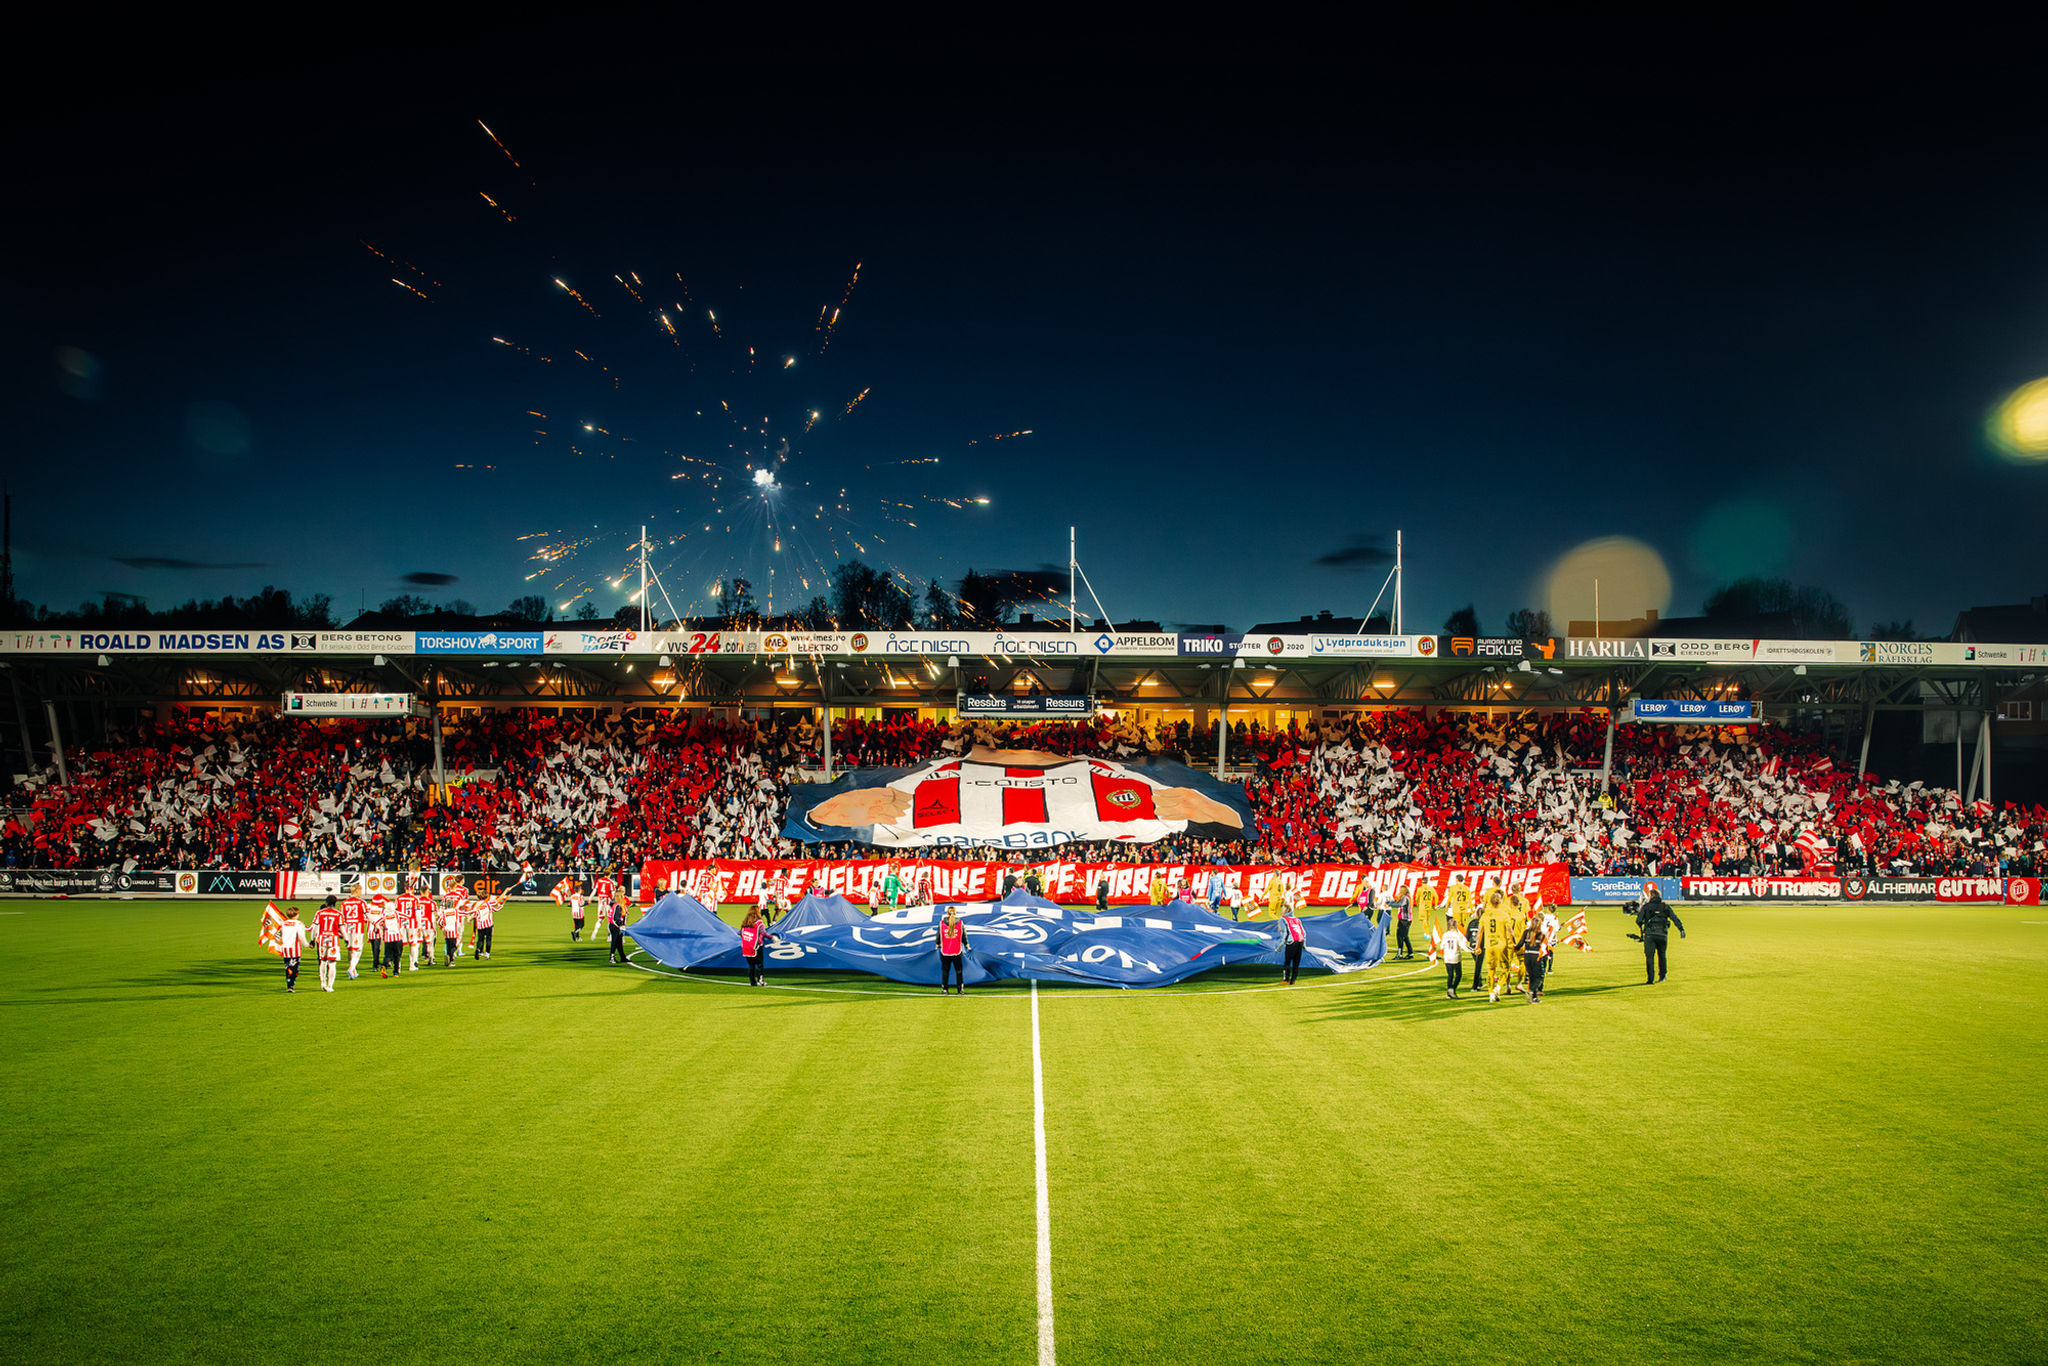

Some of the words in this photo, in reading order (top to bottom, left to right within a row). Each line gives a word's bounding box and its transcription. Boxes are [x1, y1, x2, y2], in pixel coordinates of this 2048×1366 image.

[80, 634, 151, 650] ROALD
[159, 634, 249, 650] MADSEN
[256, 634, 285, 650] AS
[419, 637, 477, 649] TORSHOV
[499, 637, 539, 650] SPORT
[886, 633, 919, 653] ÅGE
[921, 640, 970, 653] NILSEN
[1029, 640, 1078, 653] NILSEN
[1115, 637, 1175, 646] APPELBOM
[1183, 638, 1223, 653] TRIKO
[1286, 643, 1305, 651] 2020
[1326, 637, 1406, 648] Lydproduksjon
[1680, 643, 1710, 651] ODD
[1714, 643, 1751, 651] BERG
[797, 643, 839, 652] ELEKTRO
[1477, 645, 1523, 656] FOKUS
[1569, 640, 1645, 657] HARILA
[1878, 643, 1933, 655] NORGES
[1977, 650, 2008, 659] Schwenke
[305, 699, 338, 708] Schwenke
[967, 697, 1007, 707] Ressurs
[1045, 698, 1085, 708] Ressurs
[1640, 704, 1668, 712] LERØY
[1680, 704, 1707, 712] LERØY
[1719, 705, 1746, 713] LERØY
[1115, 793, 1134, 802] TIL
[239, 879, 271, 888] AVARN
[735, 867, 808, 897] ALLE
[898, 865, 987, 897] BRUKE
[1085, 863, 1185, 897] VÅRRES
[1191, 871, 1242, 899] HR
[1318, 870, 1358, 899] OG
[1592, 881, 1642, 892] SpareBank
[1689, 881, 1750, 896] FORZA
[1768, 881, 1842, 897] TROMSØ
[1866, 880, 1937, 894] ÁLFHEIMAR
[1422, 891, 1432, 901] 20
[1456, 891, 1467, 902] 25
[345, 904, 359, 919] 23
[323, 916, 336, 932] 17
[1490, 919, 1497, 934] 9
